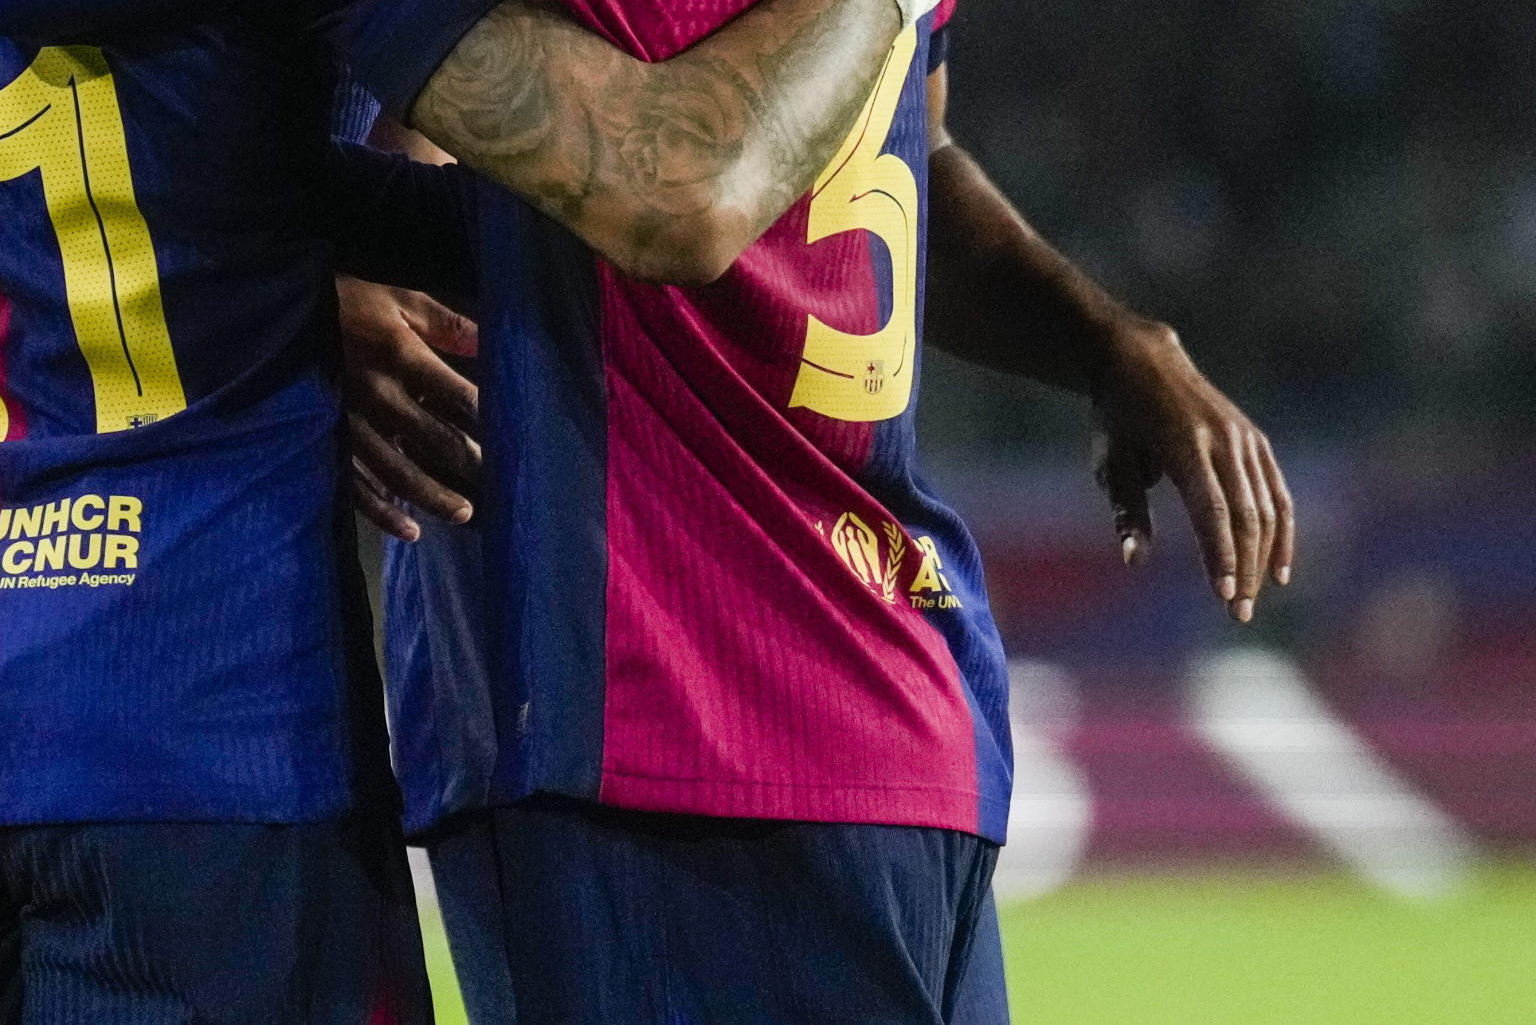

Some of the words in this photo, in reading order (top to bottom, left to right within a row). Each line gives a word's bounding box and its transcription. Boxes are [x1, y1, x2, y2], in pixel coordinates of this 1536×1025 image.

[787, 23, 919, 423] 3
[17, 573, 77, 591] Refugee
[79, 571, 136, 587] Agency
[909, 595, 936, 609] The
